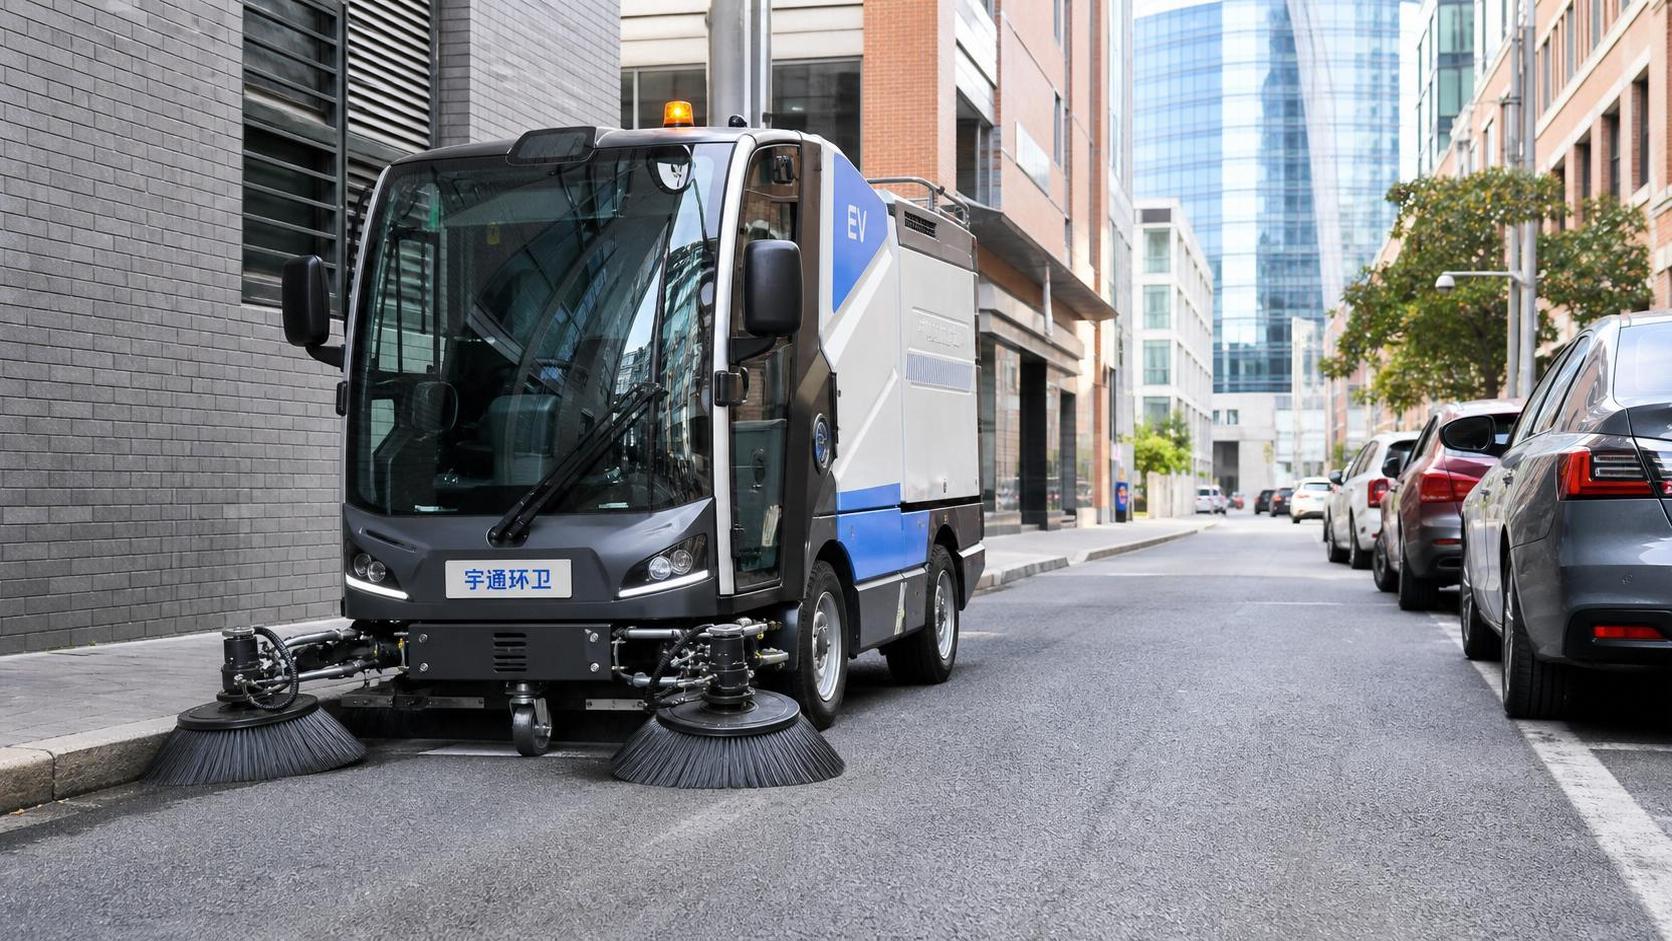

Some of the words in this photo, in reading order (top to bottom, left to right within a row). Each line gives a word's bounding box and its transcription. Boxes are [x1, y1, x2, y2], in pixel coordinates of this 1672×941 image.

[848, 204, 867, 243] EV
[464, 569, 551, 590] 宇通环卫
